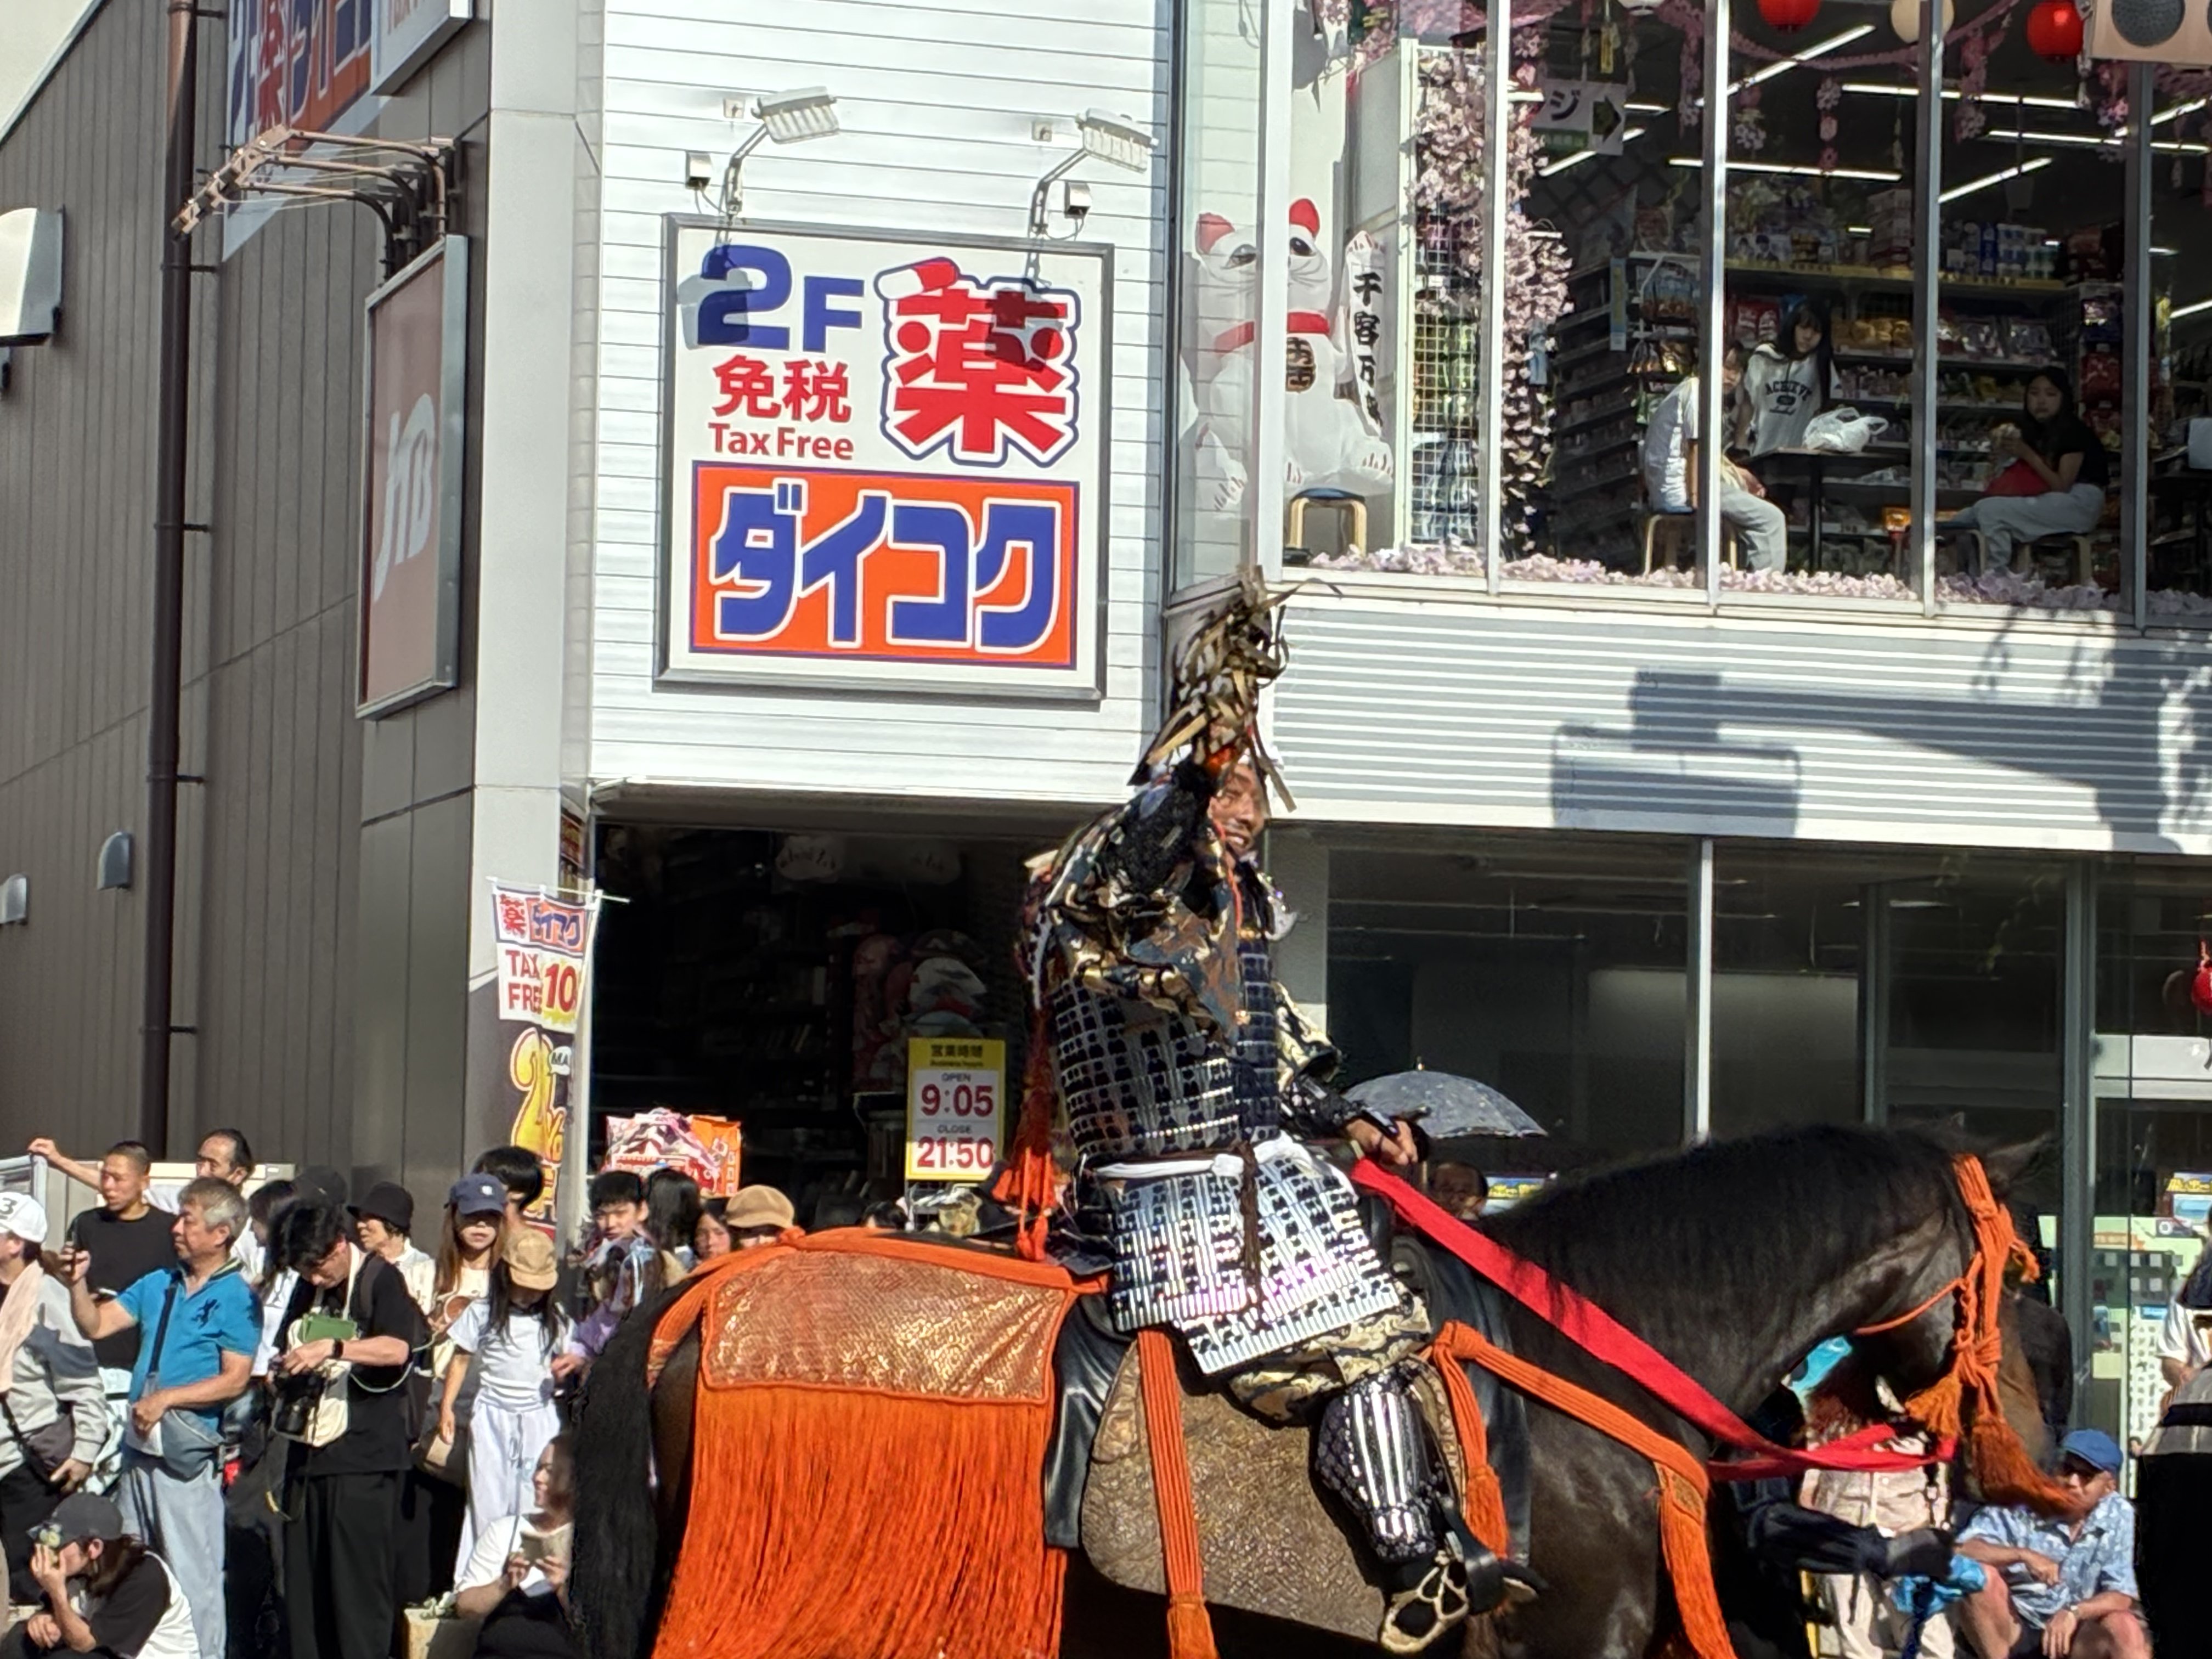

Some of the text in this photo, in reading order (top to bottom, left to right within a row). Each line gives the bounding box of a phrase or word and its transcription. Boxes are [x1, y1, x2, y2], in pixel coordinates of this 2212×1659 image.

[698, 245, 865, 353] 2F
[889, 281, 1070, 456] 薬
[712, 354, 854, 424] 免税
[707, 422, 855, 461] Tax Free
[712, 479, 1061, 653] ダイコク
[505, 950, 541, 980] TAX
[941, 1073, 971, 1082] OPEN
[921, 1084, 994, 1118] 9:05
[937, 1125, 972, 1134] CLOSE
[917, 1136, 994, 1169] 21:50
